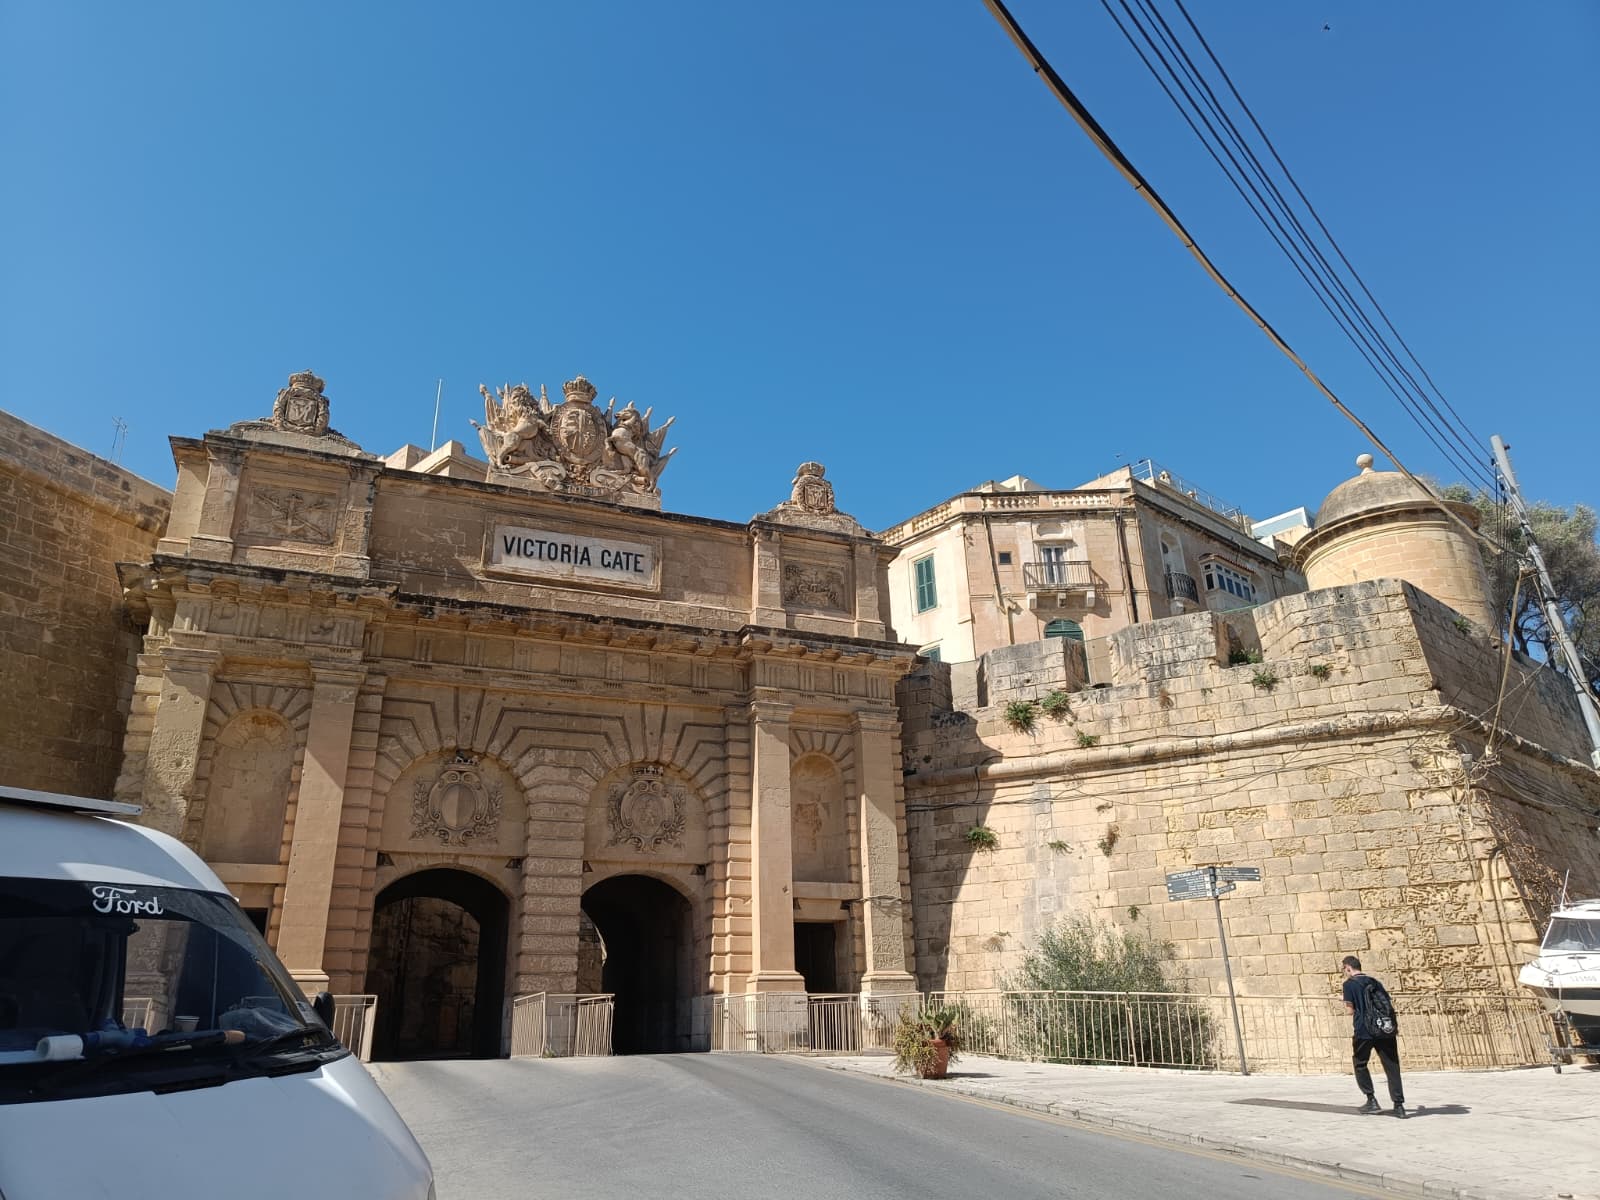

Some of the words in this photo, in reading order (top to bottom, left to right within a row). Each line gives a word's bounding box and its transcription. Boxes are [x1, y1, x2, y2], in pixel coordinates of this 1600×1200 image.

[503, 535, 592, 567] VICTORIA
[600, 549, 645, 573] GATE
[92, 885, 164, 915] Ford
